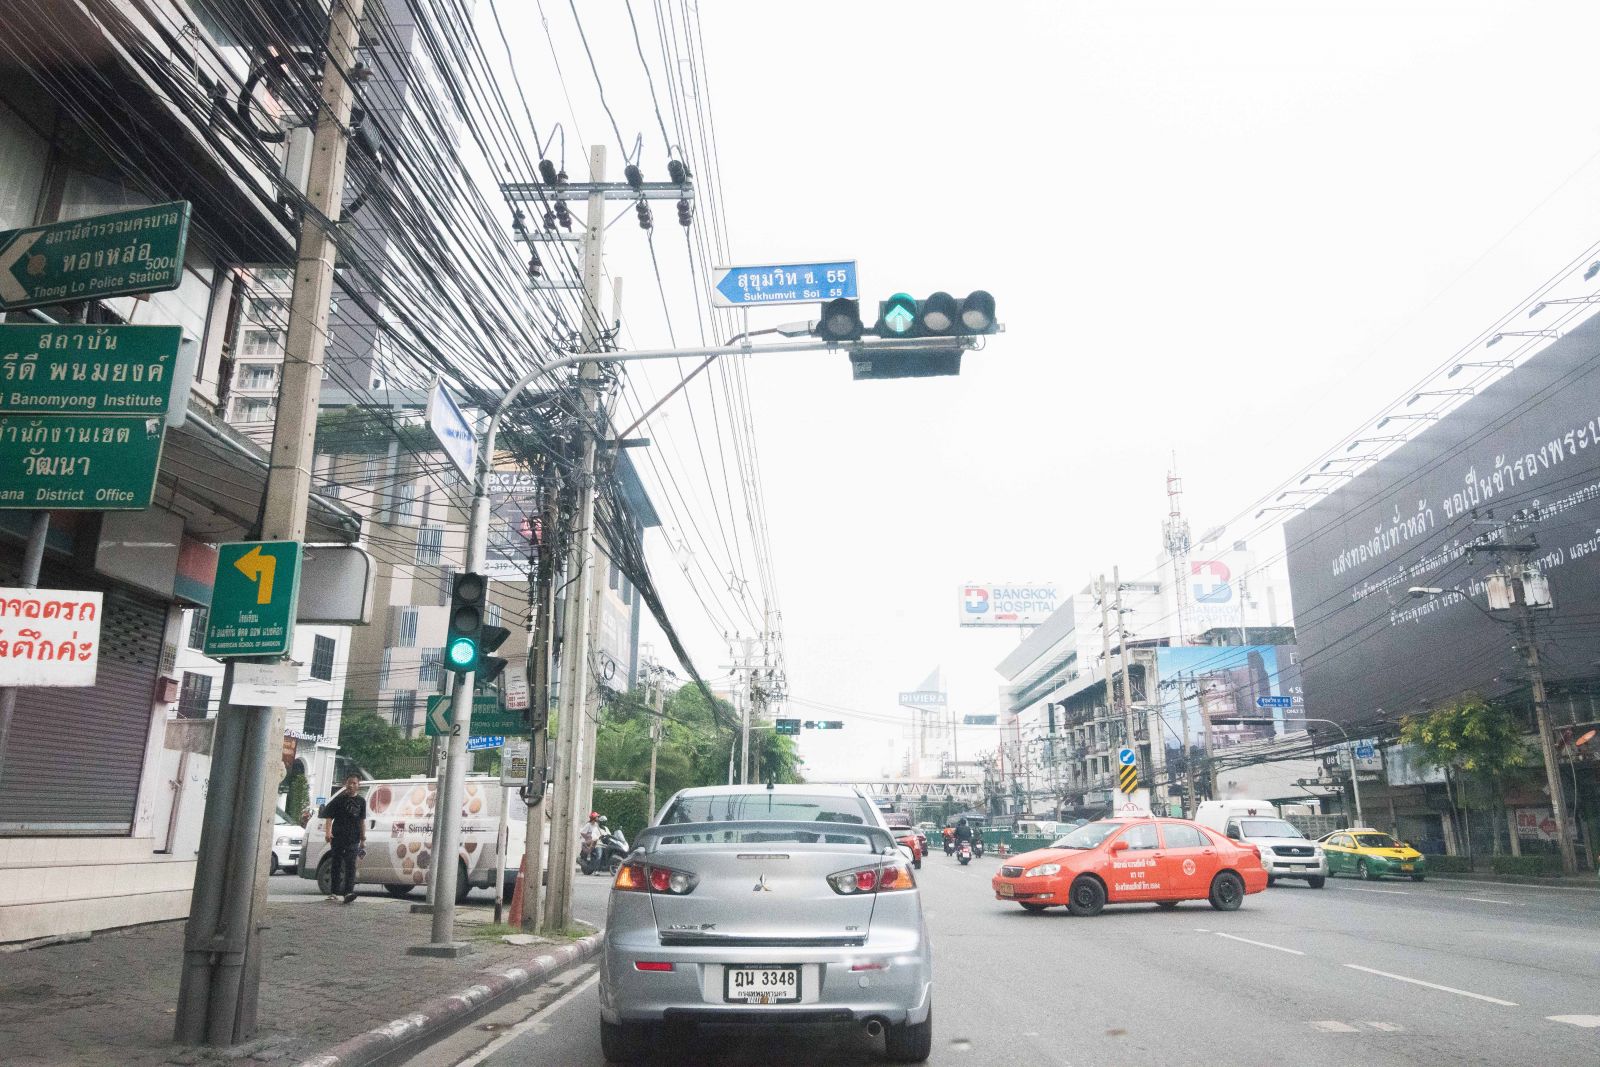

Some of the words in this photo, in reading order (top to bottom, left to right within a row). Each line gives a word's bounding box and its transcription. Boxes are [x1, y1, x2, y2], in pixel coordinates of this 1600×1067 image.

[62, 238, 151, 273] ทองหล่อ
[34, 286, 67, 298] Thong
[71, 281, 85, 292] Lo
[89, 276, 123, 290] Police
[128, 270, 169, 284] Station
[737, 269, 798, 291] สุขุมวิท
[826, 270, 847, 283] 55
[743, 291, 796, 301] Sukhumvit
[803, 290, 820, 299] Soi
[830, 289, 843, 297] 55
[39, 328, 118, 350] สถาบัน
[49, 355, 170, 382] พนมยงค์
[10, 393, 97, 409] Banomyong
[103, 393, 163, 406] Institute
[0, 418, 130, 443] ำนักงานเขต
[22, 447, 91, 476] วัฒนา
[0, 489, 24, 501] ana
[36, 488, 84, 501] District
[95, 488, 135, 502] Office
[993, 588, 1057, 600] BANGKOK
[994, 600, 1056, 613] HOSPITAL
[901, 693, 946, 704] RIVIERA
[452, 724, 461, 736] 2
[441, 751, 447, 760] 3
[762, 971, 795, 986] 3348
